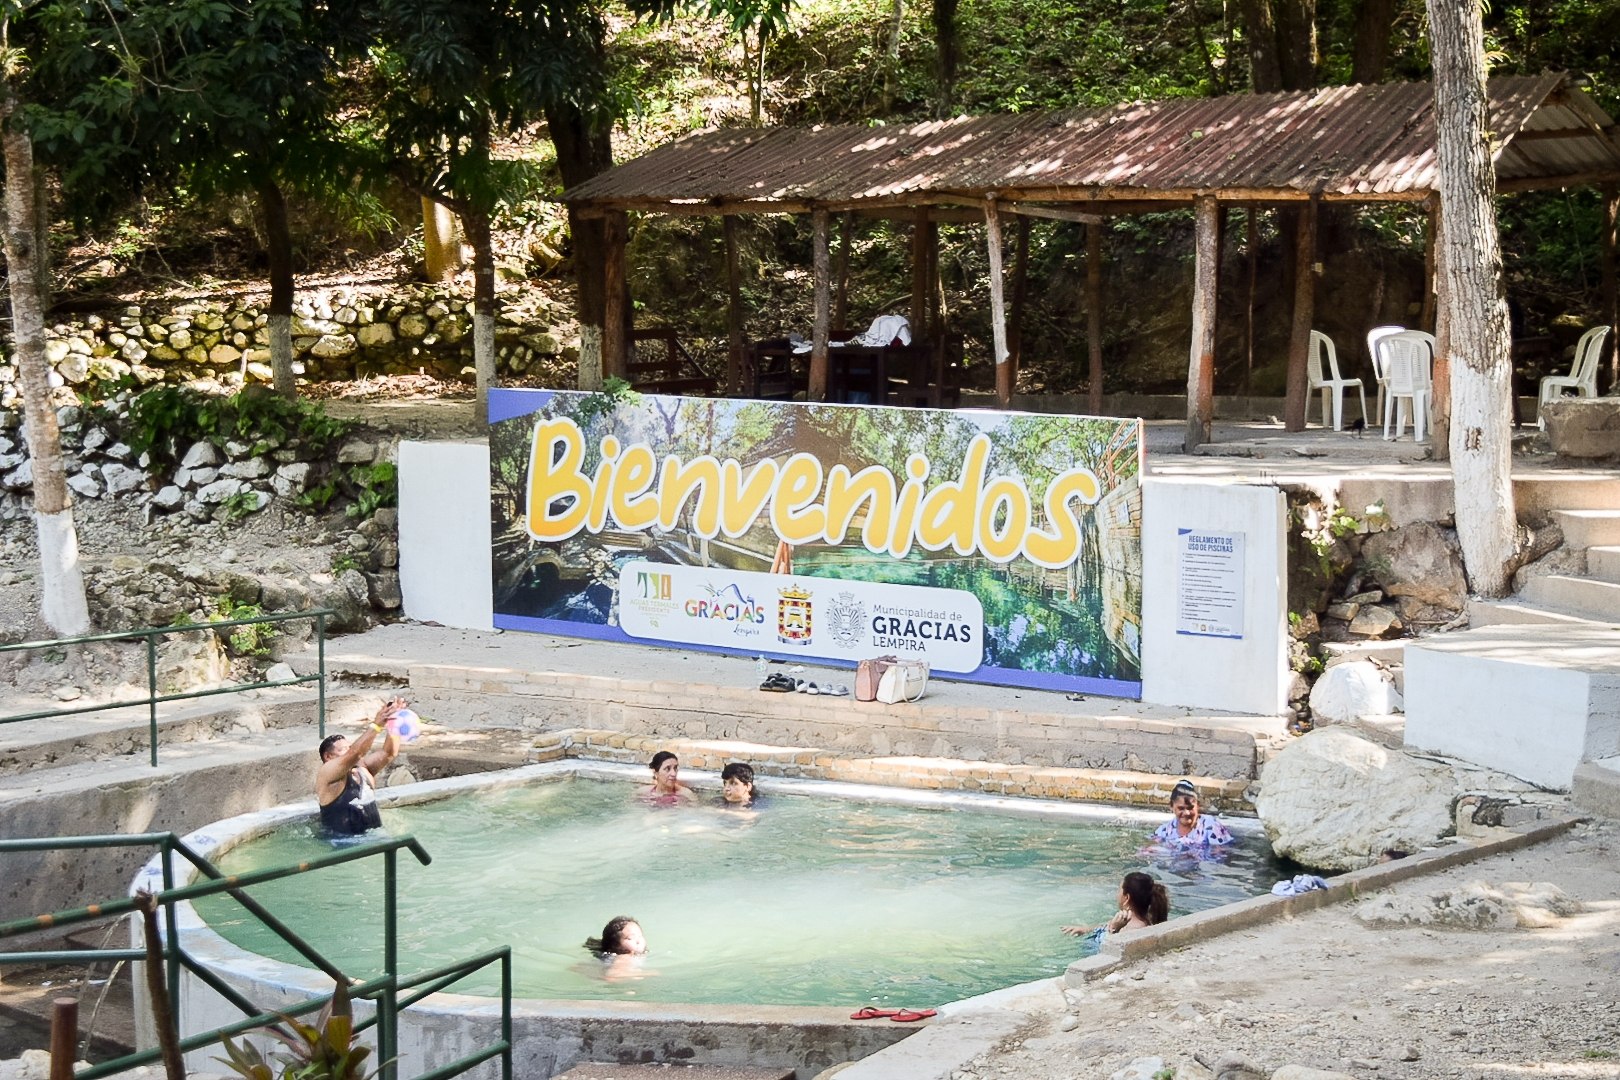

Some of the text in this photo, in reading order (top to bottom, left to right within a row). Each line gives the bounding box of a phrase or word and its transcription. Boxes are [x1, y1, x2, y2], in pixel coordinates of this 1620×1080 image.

[525, 416, 1101, 569] Bienvenidos
[1187, 543, 1234, 553] USO DE PISCINAS
[1188, 535, 1233, 546] REGLAMENTO DE
[685, 598, 765, 625] GRACIAS
[872, 604, 963, 622] Municipalidad de
[872, 615, 971, 643] GRACIAS
[872, 635, 927, 652] LEMPIRA
